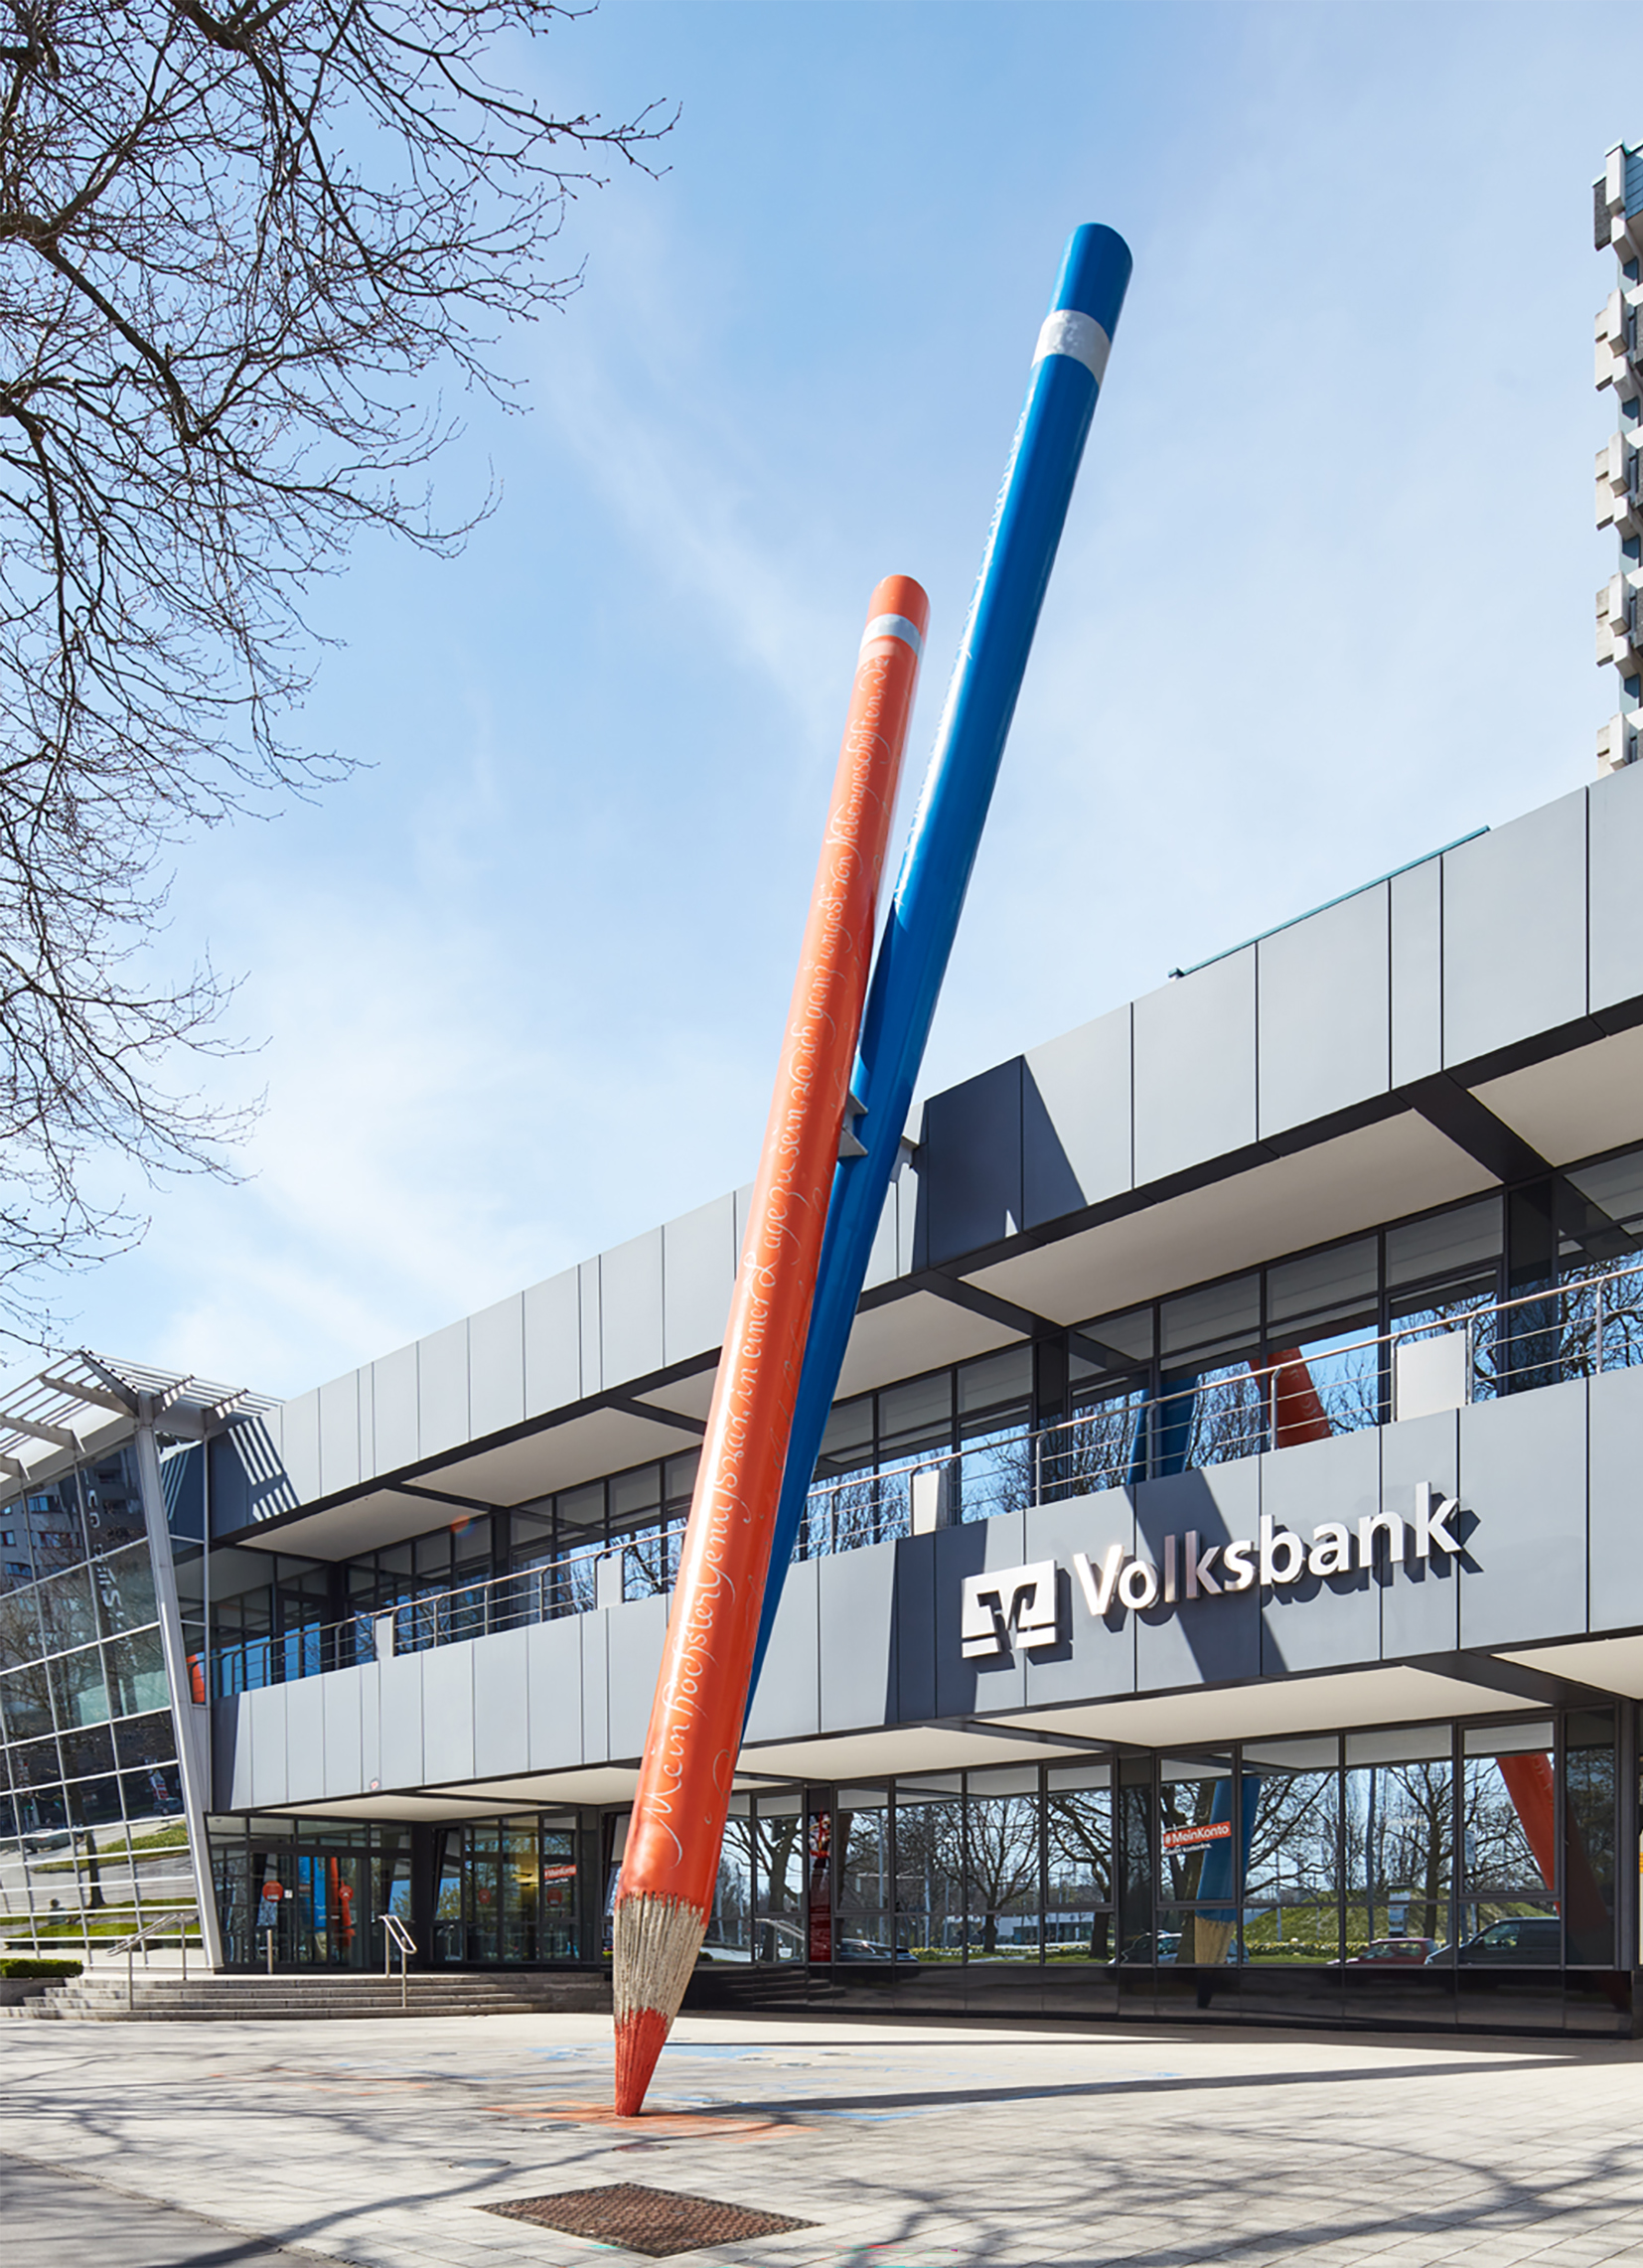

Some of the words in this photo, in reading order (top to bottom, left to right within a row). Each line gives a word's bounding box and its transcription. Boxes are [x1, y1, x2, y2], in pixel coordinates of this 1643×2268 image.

[768, 1161, 811, 1207] zu
[741, 1273, 769, 1358] einer
[728, 1367, 758, 1403] in
[1073, 1481, 1462, 1616] Volksbank
[642, 1721, 689, 1869] Mein
